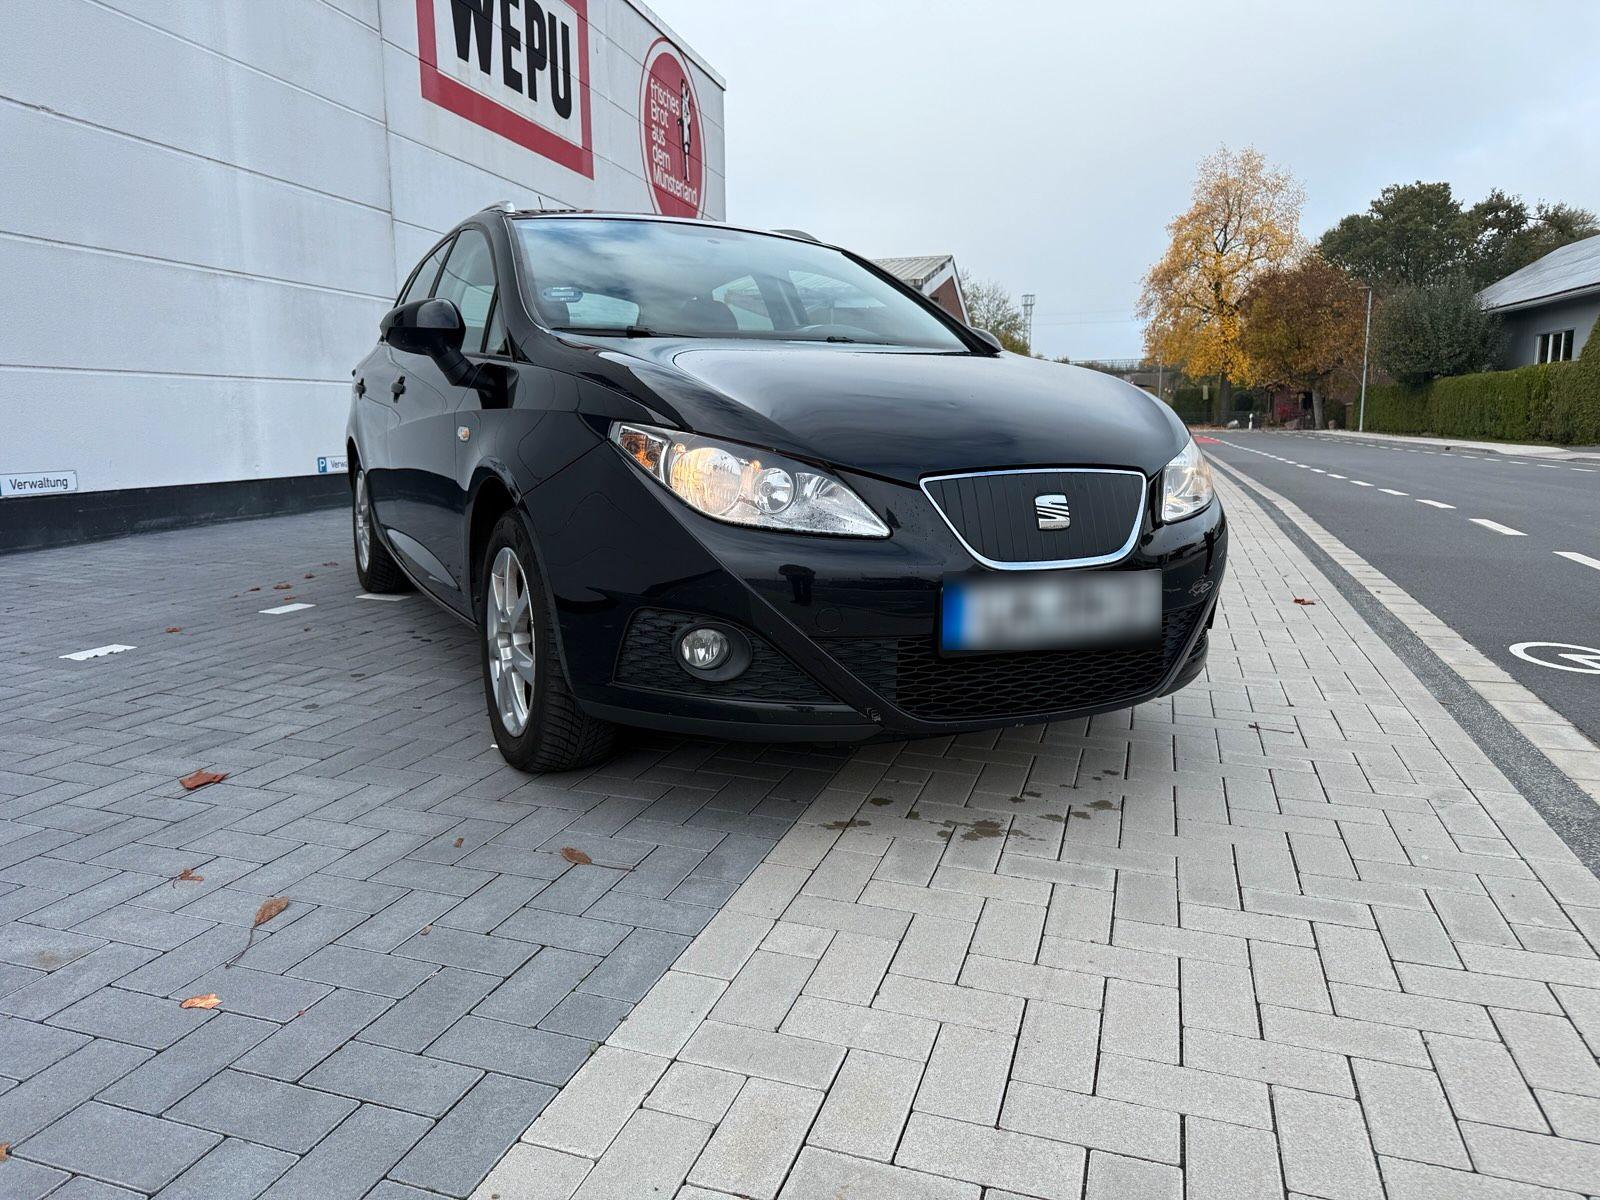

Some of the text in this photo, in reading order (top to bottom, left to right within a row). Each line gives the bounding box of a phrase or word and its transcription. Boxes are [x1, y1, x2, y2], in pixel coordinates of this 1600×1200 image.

[451, 0, 572, 120] WEPU
[651, 78, 680, 116] frisches
[651, 99, 668, 128] Brot
[652, 124, 666, 147] aus
[653, 144, 671, 171] dem
[9, 477, 68, 490] Verwaltung
